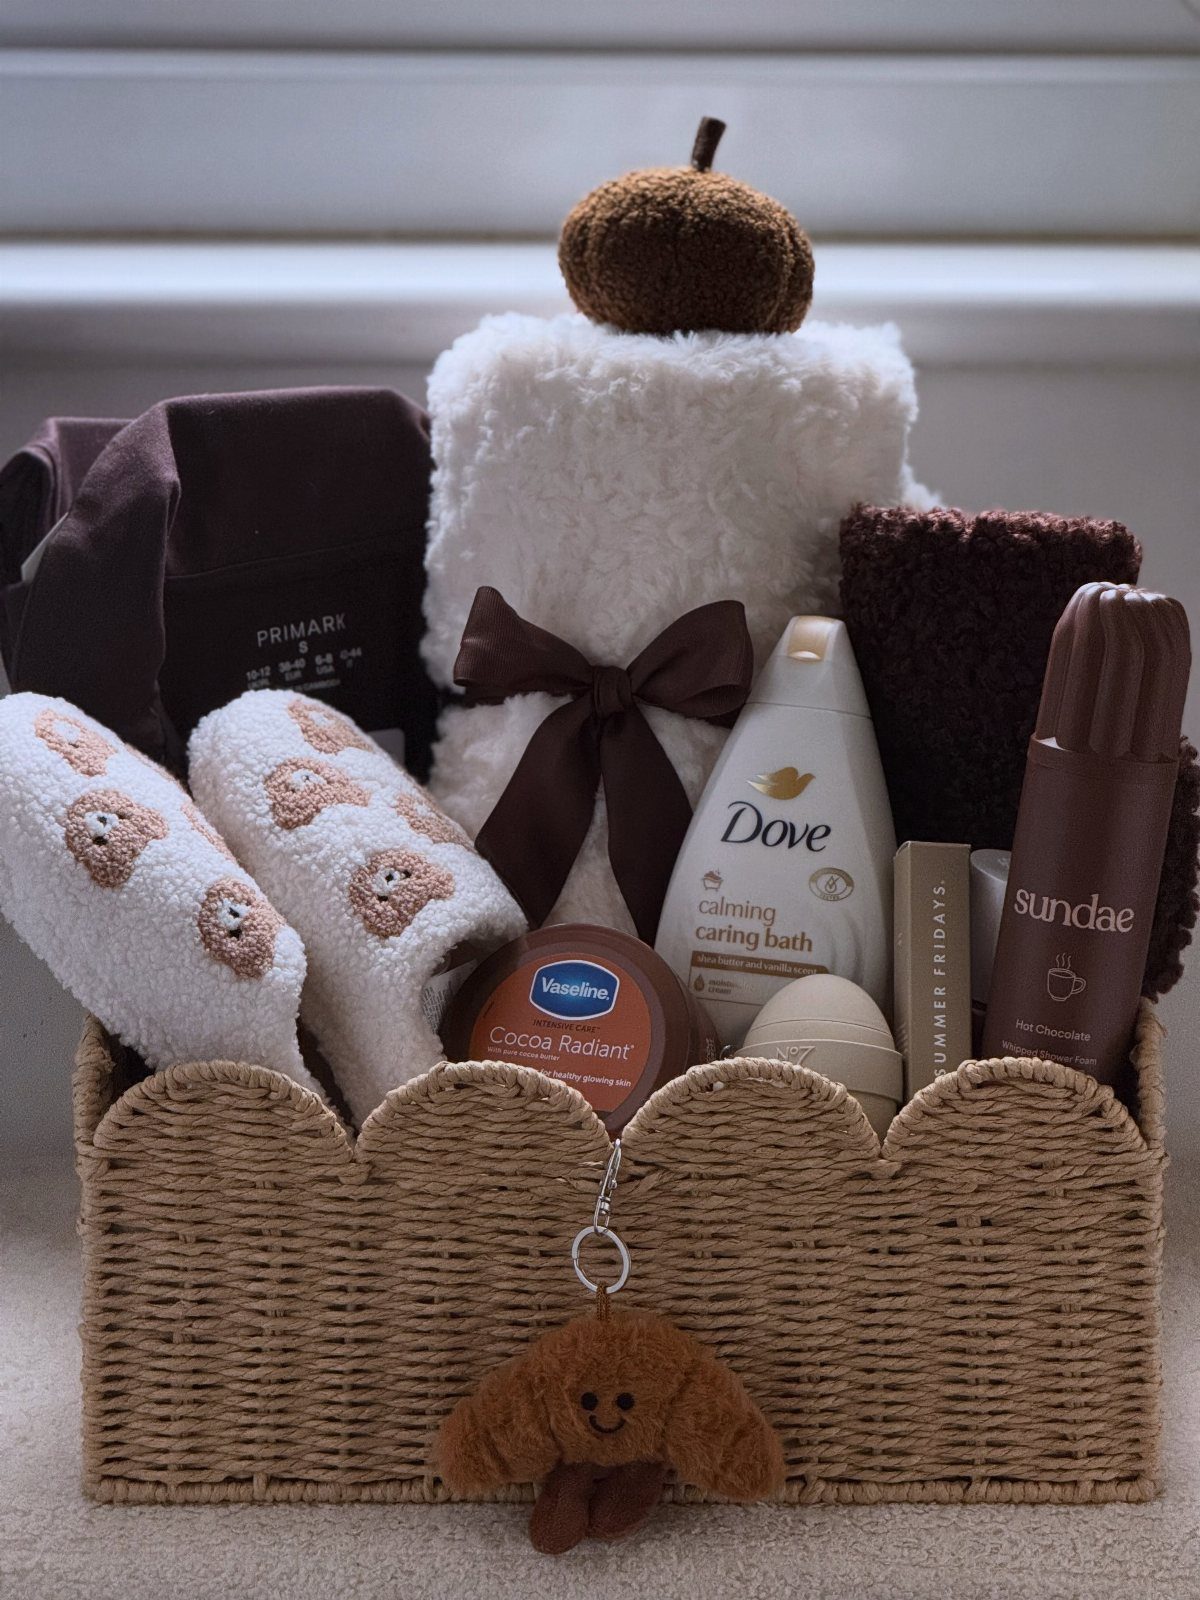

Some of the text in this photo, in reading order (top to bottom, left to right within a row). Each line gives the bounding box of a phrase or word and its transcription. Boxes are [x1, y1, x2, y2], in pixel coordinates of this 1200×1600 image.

[257, 613, 345, 647] PRIMARK
[299, 641, 308, 654] S
[246, 666, 271, 681] 10-12
[720, 801, 831, 852] Dove
[698, 896, 777, 926] calming
[1014, 888, 1135, 933] sundae
[695, 924, 813, 953] caring bath
[697, 953, 717, 964] shea
[718, 957, 744, 968] butter
[745, 960, 763, 970] and
[763, 962, 792, 973] vanilla
[532, 1019, 573, 1031] INTENSIVE
[934, 986, 947, 1077] SUMMER
[1015, 1019, 1091, 1042] Hot Chocolate
[489, 1026, 552, 1050] Cocoa
[487, 1046, 560, 1061] With pure cocoa butter
[1002, 1040, 1097, 1066] Whipped Shower Foam
[552, 1070, 582, 1081] healthy
[582, 1075, 615, 1087] glowing
[615, 1078, 632, 1087] skin
